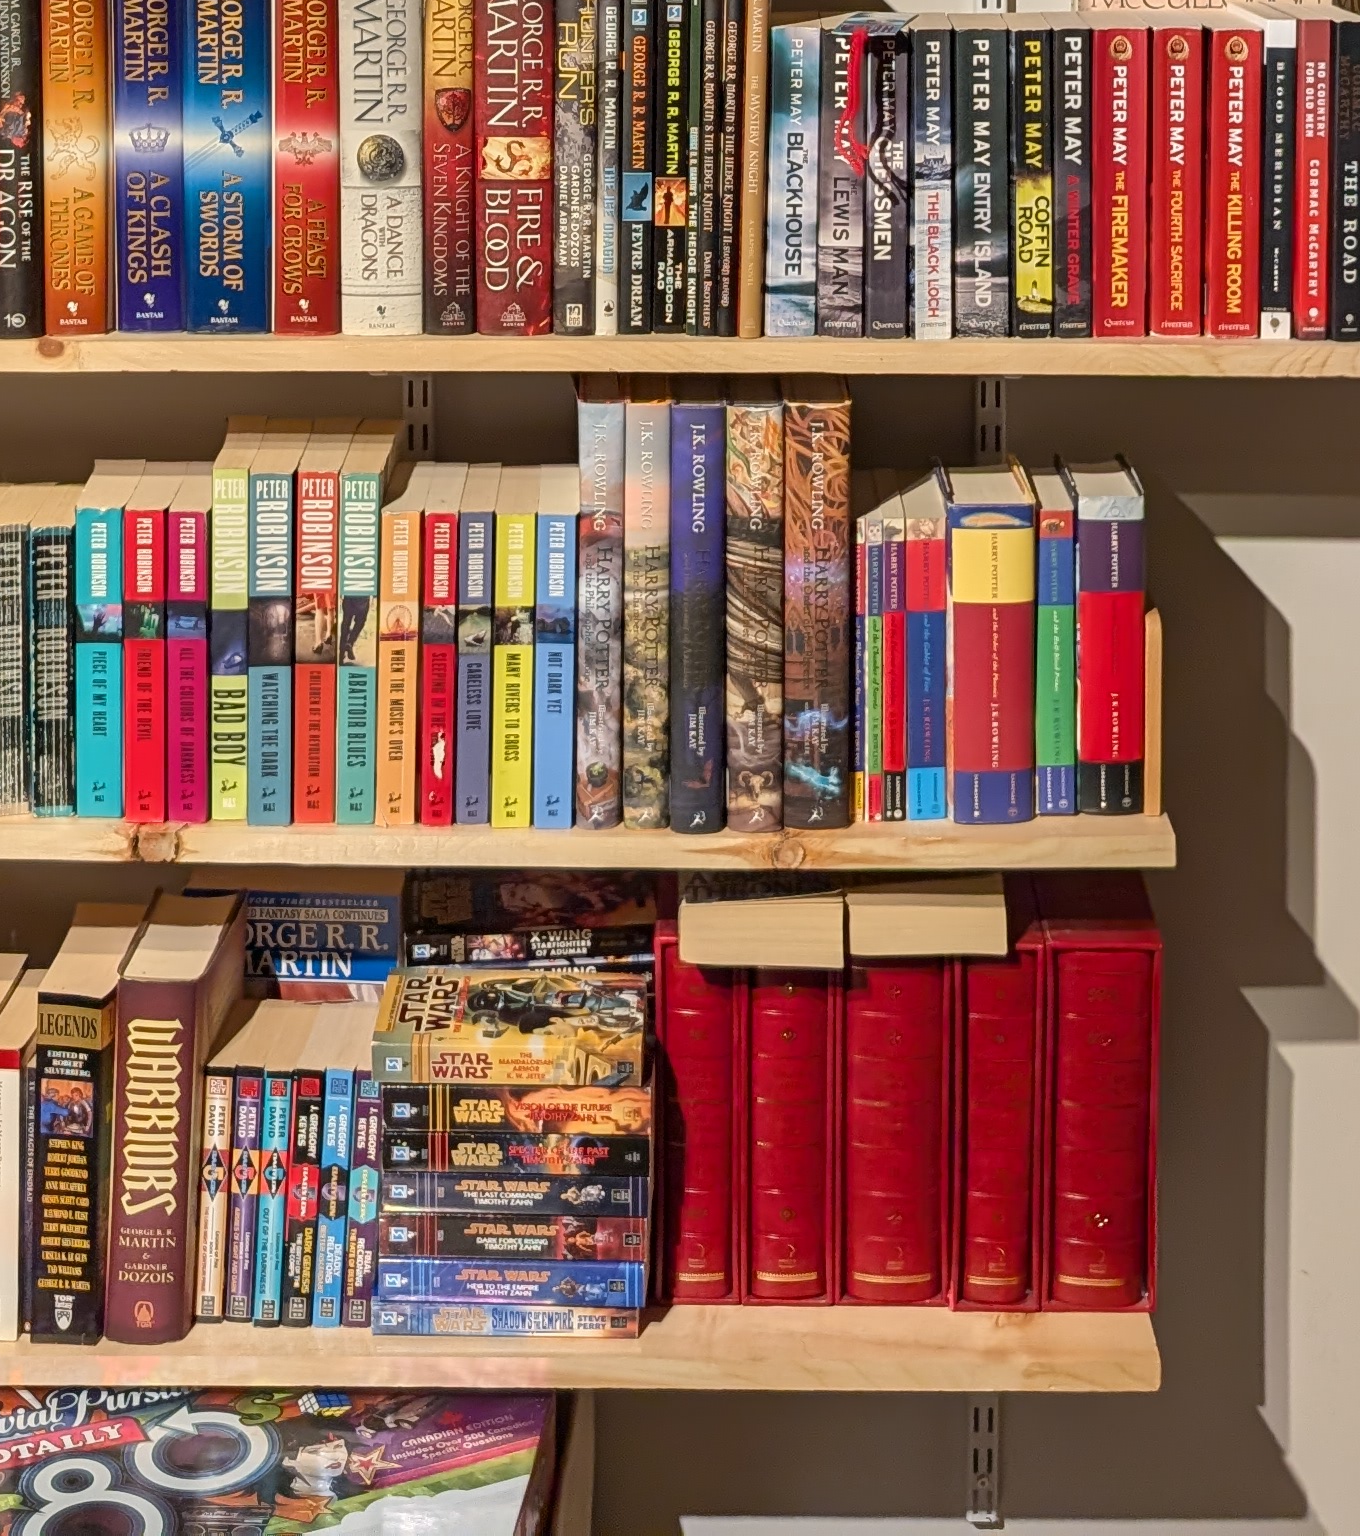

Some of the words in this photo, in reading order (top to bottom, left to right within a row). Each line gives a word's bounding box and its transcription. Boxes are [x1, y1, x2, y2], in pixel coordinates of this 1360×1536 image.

[559, 22, 577, 99] RUN
[1115, 170, 1124, 191] THE
[1344, 162, 1357, 208] THE
[517, 188, 542, 240] FIRE
[972, 172, 991, 242] ENTRY
[485, 188, 511, 291] BLOOD
[1018, 206, 1033, 264] ROAD
[1033, 196, 1050, 268] COFFIN
[1111, 195, 1128, 308] FIREMAKER
[1344, 220, 1357, 284] ROAD
[518, 255, 542, 287] &
[973, 244, 991, 307] ISLAND
[692, 424, 704, 457] J.K.
[256, 481, 288, 499] PETER
[692, 463, 705, 533] ROWLING
[256, 502, 288, 592] ROBINSON
[215, 687, 246, 724] BAD
[214, 729, 246, 765] BOY
[530, 930, 591, 941] X-WING
[40, 1014, 98, 1039] LEGENDS
[432, 1066, 492, 1078] WARS
[438, 1053, 489, 1066] STAR
[578, 1314, 606, 1322] STEVE
[578, 1321, 606, 1331] PERRY
[400, 1425, 461, 1450] CANADIAN
